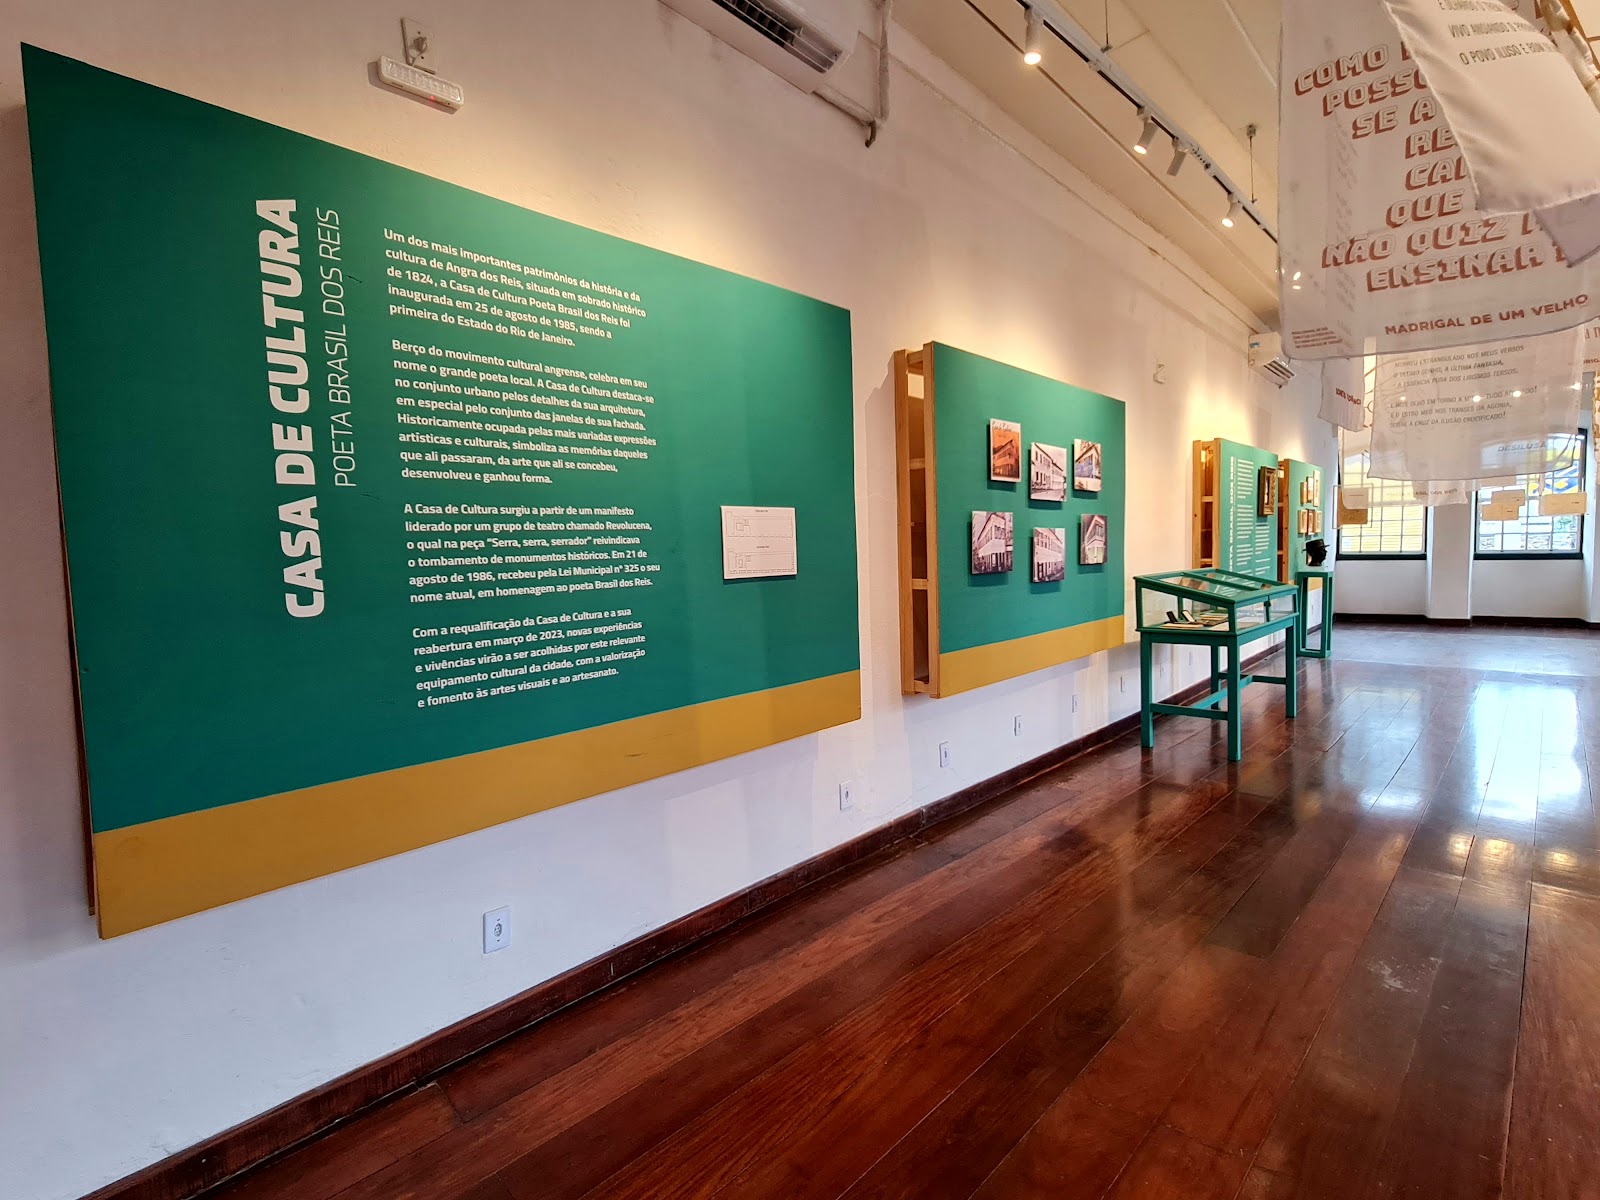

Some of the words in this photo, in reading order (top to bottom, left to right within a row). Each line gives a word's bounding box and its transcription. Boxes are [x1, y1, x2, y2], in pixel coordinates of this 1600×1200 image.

[1295, 44, 1389, 96] COMO
[1459, 52, 1469, 65] O
[1470, 48, 1496, 62] POVO
[1352, 105, 1398, 139] SE
[1385, 188, 1465, 229] QUE
[316, 207, 342, 261] REIS
[1321, 232, 1396, 269] NÃO
[1406, 216, 1510, 257] QUIZ
[384, 228, 405, 243] Um
[407, 234, 429, 248] dos
[431, 242, 458, 256] mais
[459, 247, 522, 272] importantes
[523, 265, 578, 286] patrimônios
[578, 278, 591, 290] da
[591, 280, 623, 298] história
[623, 291, 629, 299] e
[630, 291, 640, 302] da
[385, 249, 427, 266] cultura
[429, 257, 444, 270] de
[445, 261, 478, 278] Angra
[479, 269, 498, 282] dos
[500, 274, 524, 290] Reis,
[525, 281, 561, 297] situada
[561, 290, 576, 301] em
[577, 294, 611, 309] sobrado
[612, 300, 646, 317] histórico
[1366, 241, 1543, 293] ENSINAR
[256, 199, 310, 414] CULTURA
[320, 265, 345, 316] DOS
[389, 304, 439, 321] primeira
[440, 312, 455, 324] do
[457, 315, 494, 331] Estado
[495, 322, 508, 334] do
[509, 325, 526, 337] Rio
[527, 328, 540, 340] de
[541, 331, 575, 346] Janeiro.
[1385, 317, 1465, 335] MADRIGAL
[1470, 313, 1493, 326] DE
[1498, 309, 1525, 321] UM
[1531, 293, 1588, 316] VELHO
[324, 324, 351, 404] BRASIL
[392, 339, 426, 356] Berço
[428, 345, 443, 357] do
[444, 349, 505, 366] movimento
[506, 358, 543, 372] cultural
[544, 365, 588, 380] angrense,
[588, 372, 619, 384] celebra
[619, 377, 632, 386] em
[633, 379, 648, 388] seu
[394, 378, 410, 388] no
[412, 380, 462, 394] conjunto
[463, 385, 500, 398] urbano
[502, 391, 529, 402] pelos
[530, 393, 570, 407] detalhes
[570, 398, 582, 409] da
[582, 402, 599, 411] sua
[599, 404, 646, 418] arquitetura,
[396, 397, 415, 406] em
[417, 399, 463, 411] especial
[465, 403, 488, 414] pelo
[489, 406, 532, 418] conjunto
[533, 409, 551, 420] das
[551, 411, 584, 424] janelas
[584, 415, 596, 425] de
[596, 418, 612, 427] sua
[612, 418, 646, 430] fachada.
[330, 411, 357, 487] POETA
[397, 412, 483, 430] Historicamente
[484, 423, 527, 434] ocupada
[527, 426, 553, 437] pelas
[554, 428, 576, 438] mais
[577, 430, 613, 442] variadas
[613, 435, 656, 446] expressões
[398, 432, 452, 445] artísticas
[454, 437, 462, 445] e
[463, 436, 510, 450] culturais,
[512, 440, 557, 452] simboliza
[558, 445, 569, 453] as
[570, 446, 612, 456] memórias
[612, 447, 648, 460] daqueles
[271, 423, 316, 485] DE
[401, 467, 472, 480] desenvolveu
[474, 472, 481, 480] e
[482, 471, 520, 483] ganhou
[521, 472, 553, 483] forma.
[405, 521, 452, 531] liderado
[453, 523, 472, 534] por
[474, 523, 491, 531] um
[492, 523, 522, 533] grupo
[523, 521, 536, 530] de
[536, 521, 565, 530] teatro
[565, 521, 605, 530] chamado
[605, 520, 652, 530] Revolucena,
[278, 496, 325, 618] CASA
[407, 559, 416, 567] o
[417, 555, 488, 567] tombamento
[490, 554, 503, 564] de
[504, 552, 567, 563] monumentos
[567, 550, 611, 560] históricos.
[611, 550, 625, 559] Em
[625, 550, 636, 558] 21
[637, 549, 647, 558] de
[413, 641, 473, 655] reabertura
[474, 639, 491, 648] em
[493, 635, 524, 646] março
[525, 632, 538, 642] de
[539, 629, 565, 640] 2023,
[566, 627, 592, 637] novas
[593, 620, 642, 634] experiências
[416, 672, 488, 691] equipamento
[490, 664, 527, 679] cultural
[528, 663, 541, 673] da
[542, 659, 574, 671] cidade,
[575, 657, 594, 666] com
[601, 648, 645, 662] valorização
[417, 699, 425, 708] e
[426, 691, 474, 706] fomento
[476, 688, 488, 698] às
[490, 684, 516, 696] artes
[517, 677, 550, 691] visuais
[571, 668, 619, 682] artesanato.
